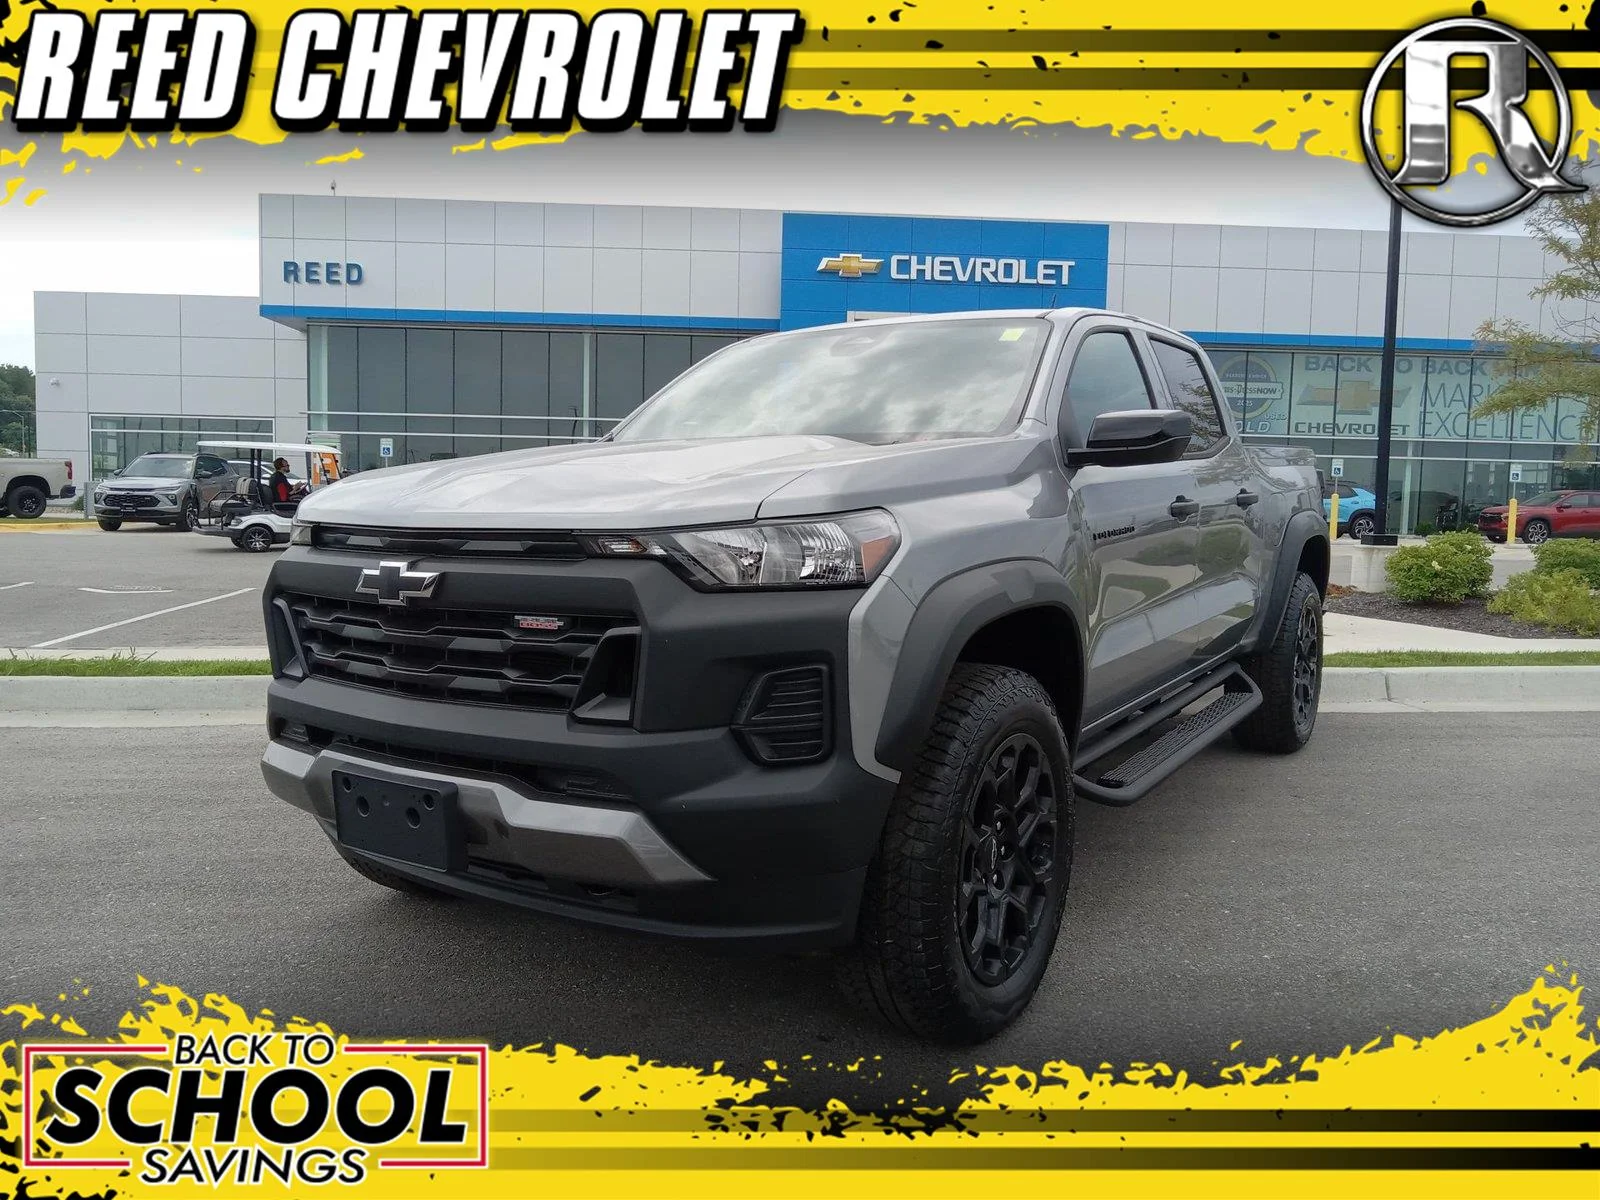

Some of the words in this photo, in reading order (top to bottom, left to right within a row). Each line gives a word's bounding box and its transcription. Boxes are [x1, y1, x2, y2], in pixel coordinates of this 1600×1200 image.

[283, 261, 364, 285] REED
[890, 254, 1076, 286] CHEVROLET
[1304, 355, 1373, 373] BACK
[1421, 359, 1487, 376] BACK
[1294, 421, 1411, 436] CHEVROET
